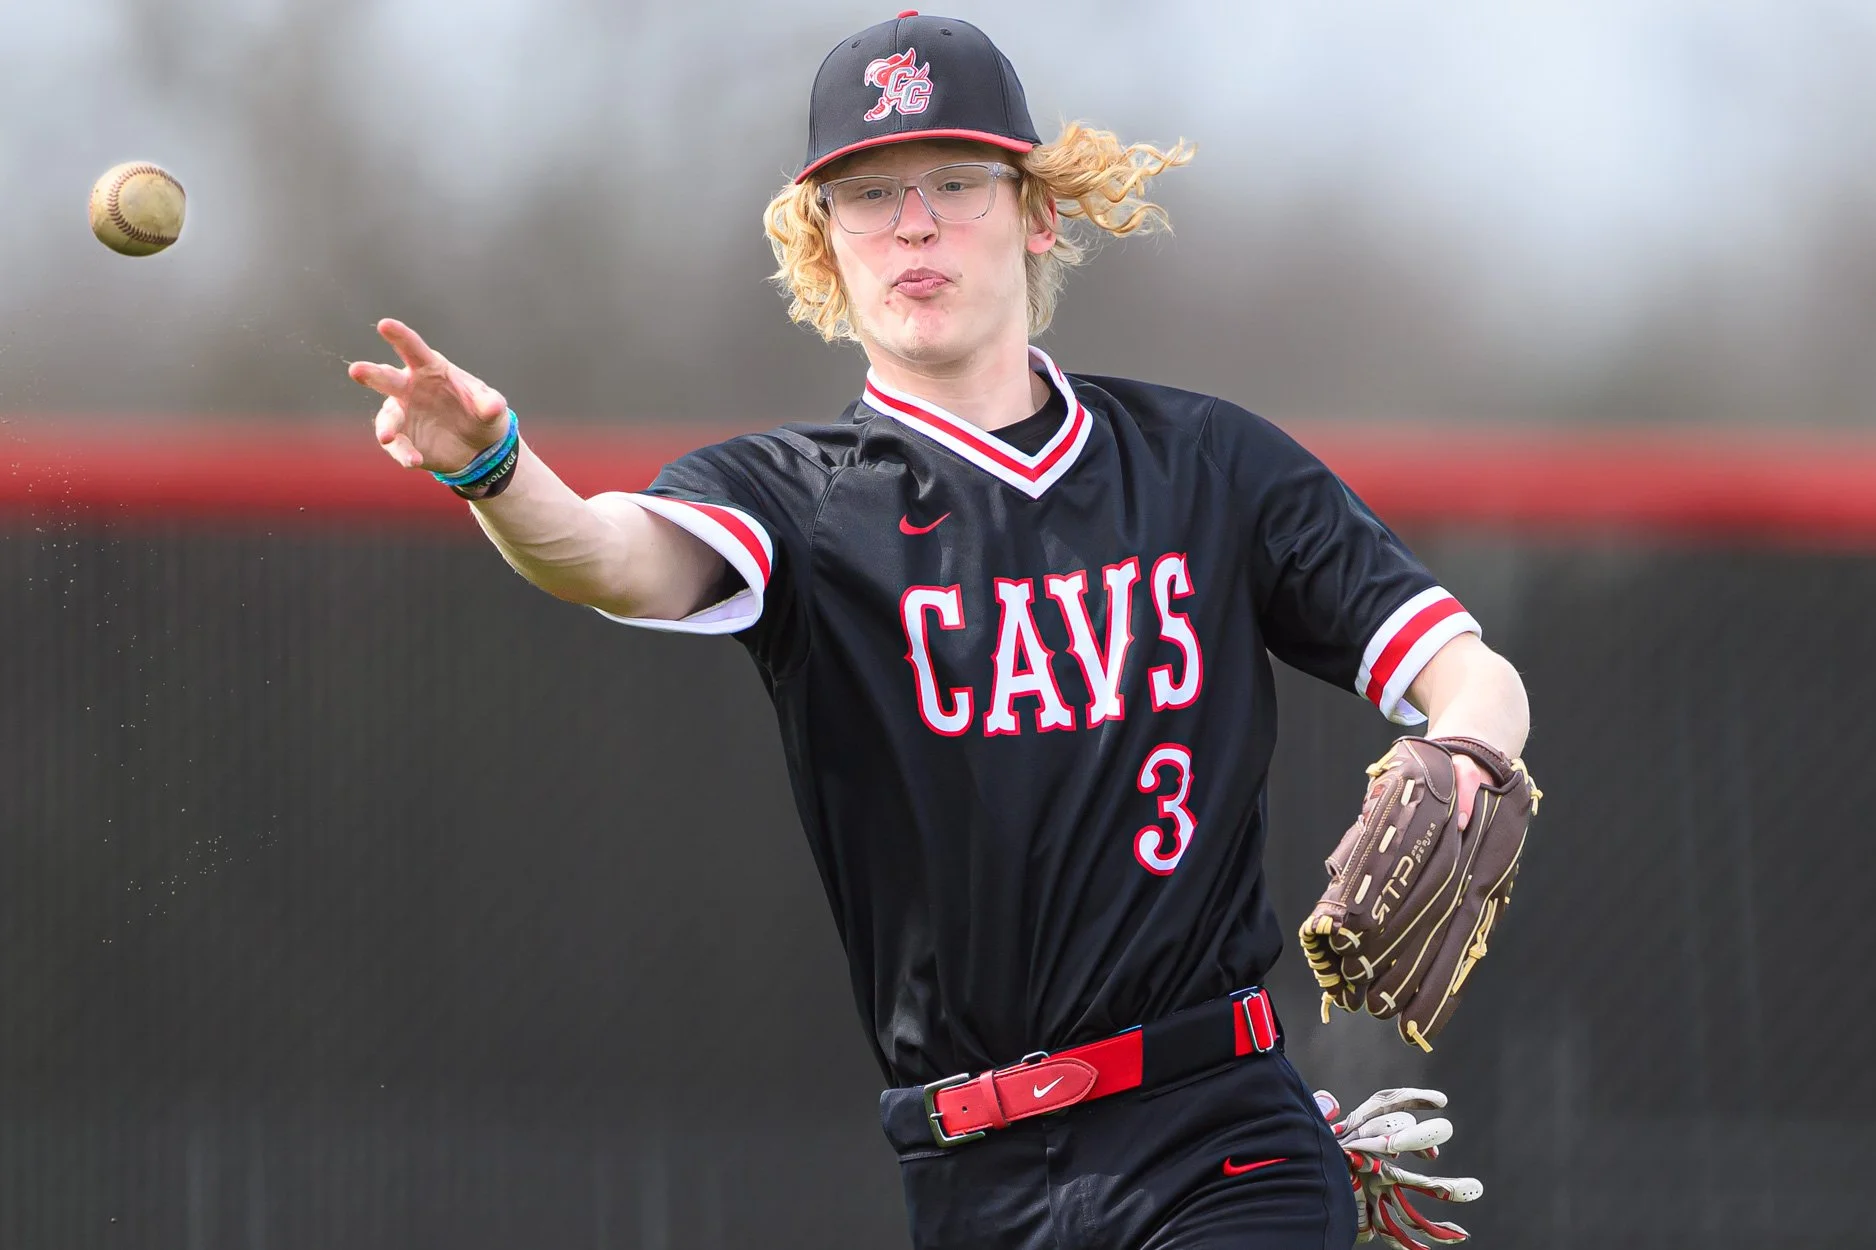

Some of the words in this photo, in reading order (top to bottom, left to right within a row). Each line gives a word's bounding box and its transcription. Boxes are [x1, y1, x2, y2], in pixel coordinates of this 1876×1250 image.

[485, 450, 517, 486] COLLEGE
[900, 552, 1204, 738] CAVS
[1133, 742, 1198, 876] 3
[1371, 855, 1414, 925] STP
